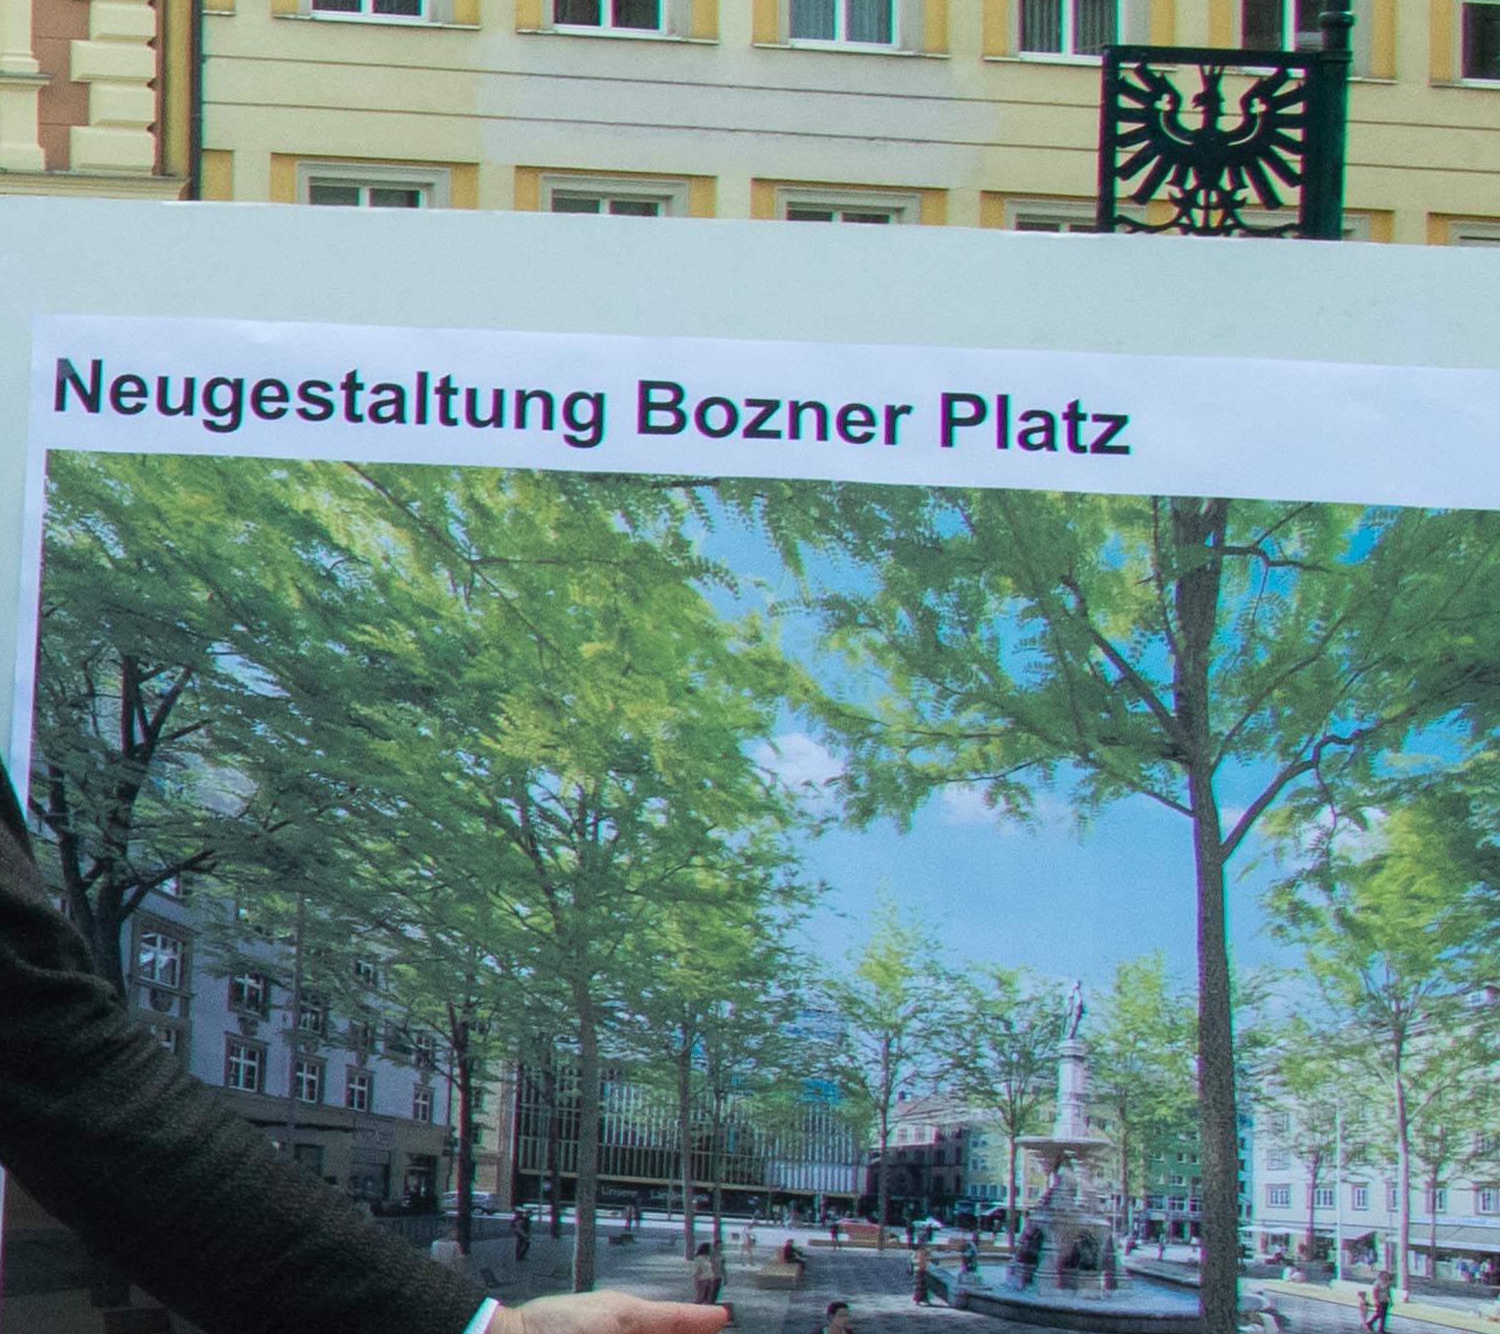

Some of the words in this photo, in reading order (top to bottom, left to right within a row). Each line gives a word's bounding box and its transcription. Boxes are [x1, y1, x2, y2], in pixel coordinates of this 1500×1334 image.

[53, 357, 606, 450] Neugestaltung
[636, 378, 915, 447] Bozner
[939, 391, 1132, 457] Platz
